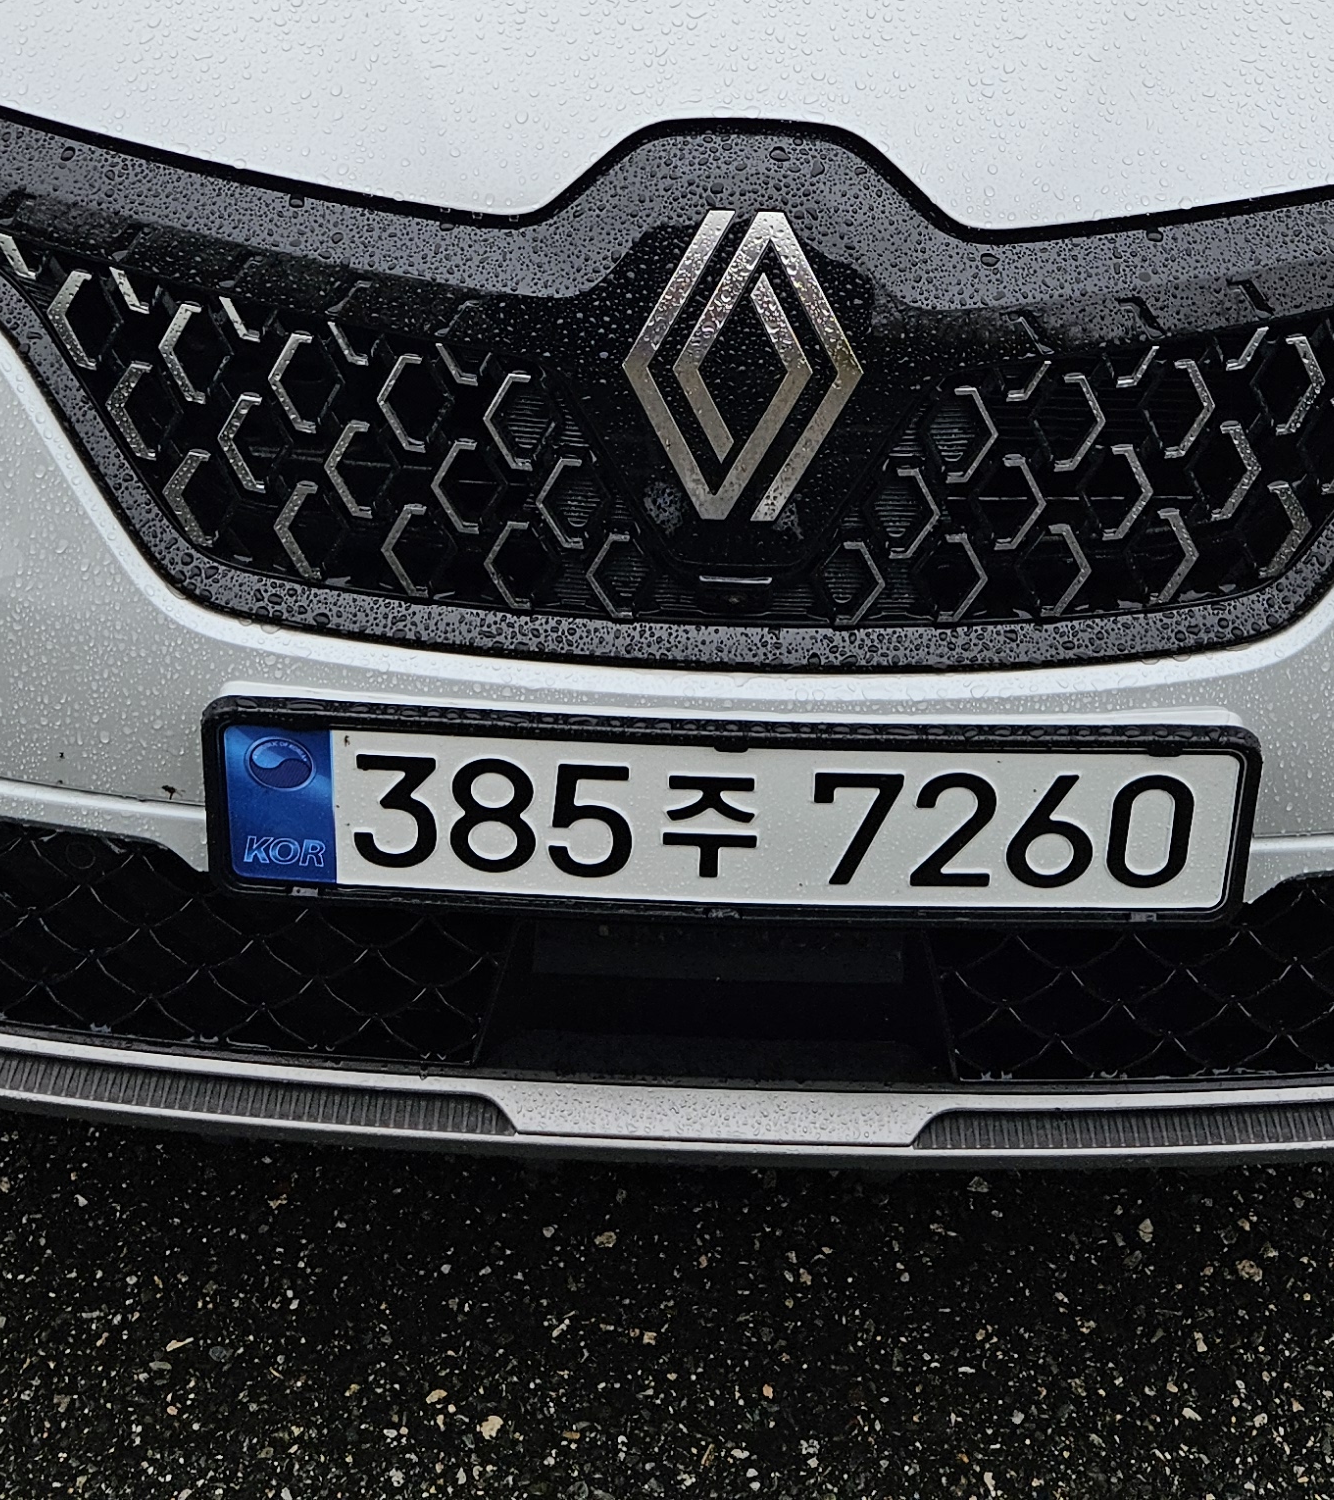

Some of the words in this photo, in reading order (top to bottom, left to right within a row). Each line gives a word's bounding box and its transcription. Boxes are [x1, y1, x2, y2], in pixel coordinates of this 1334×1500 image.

[243, 835, 326, 868] KOR
[353, 753, 759, 879] 385주
[813, 771, 1196, 889] 7260
